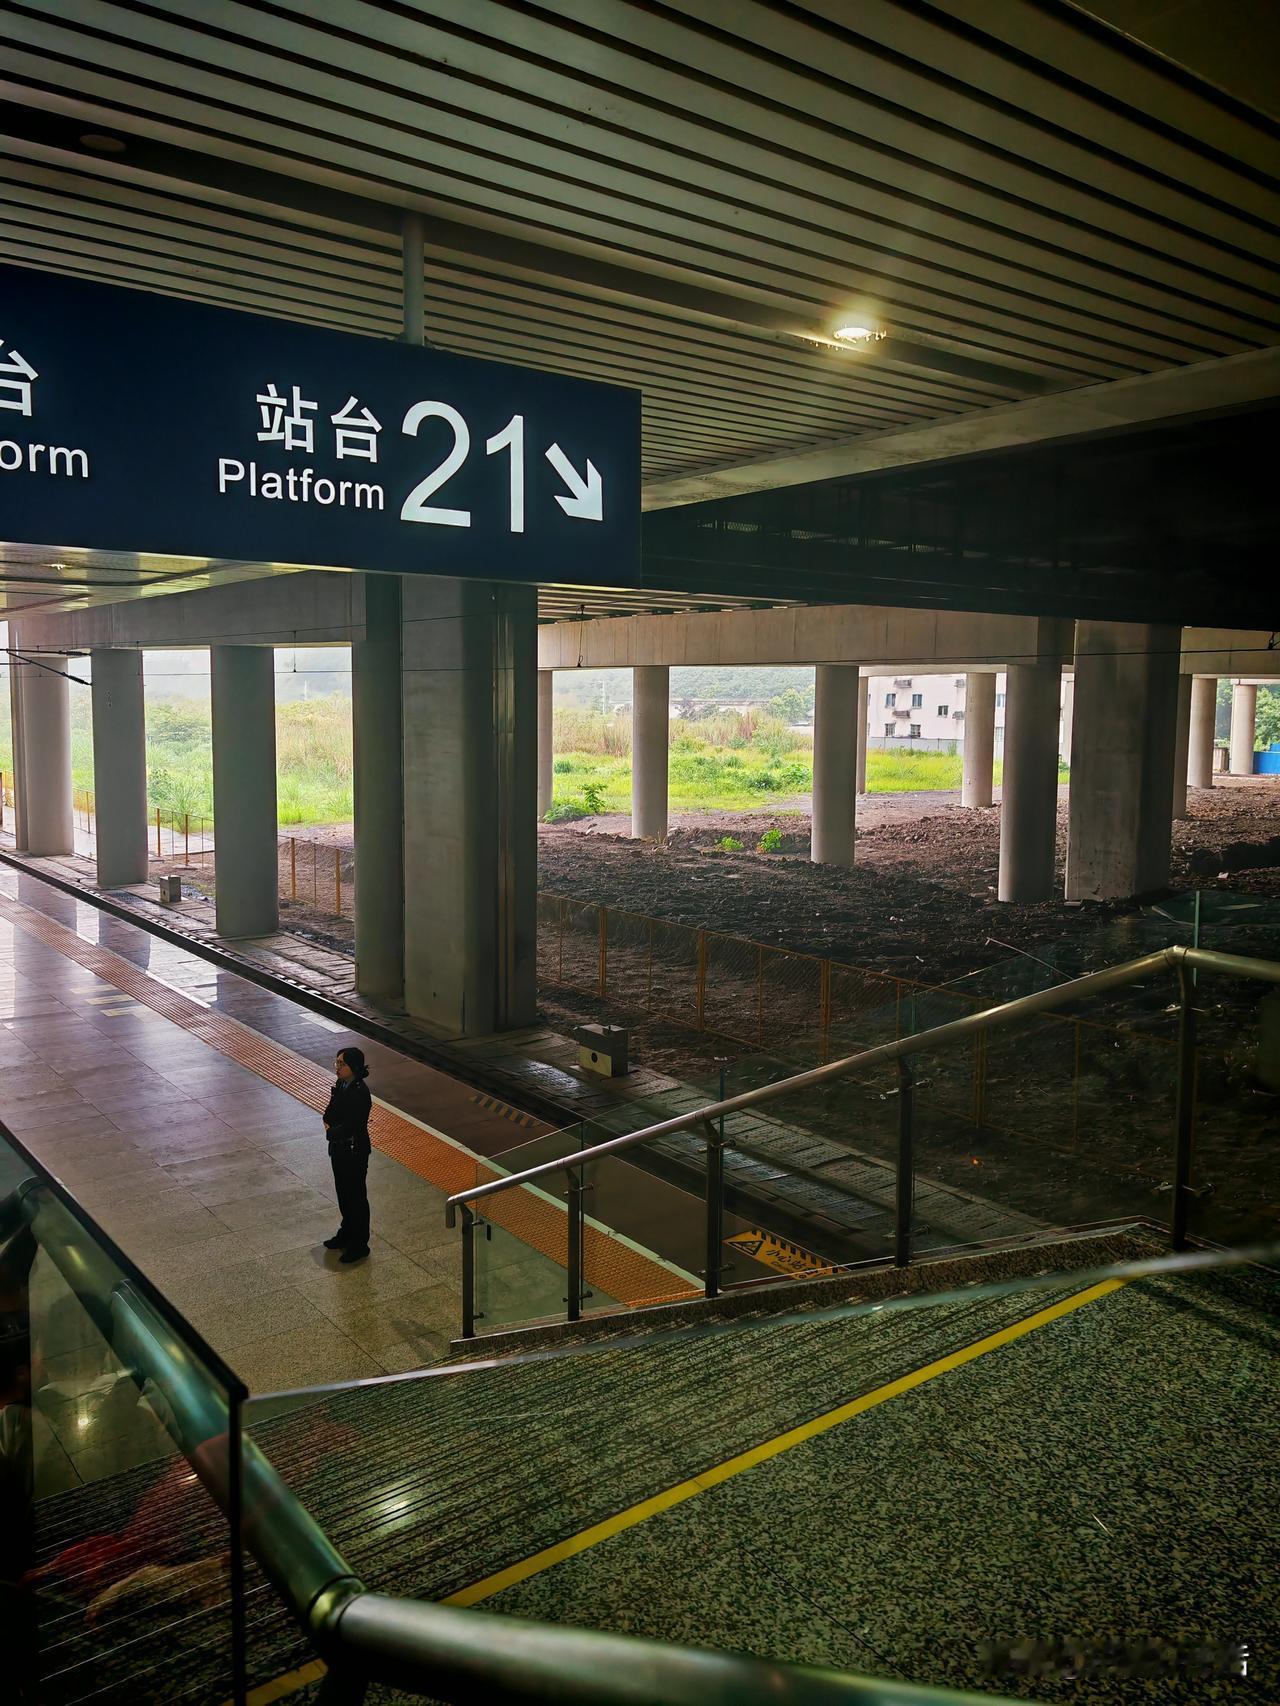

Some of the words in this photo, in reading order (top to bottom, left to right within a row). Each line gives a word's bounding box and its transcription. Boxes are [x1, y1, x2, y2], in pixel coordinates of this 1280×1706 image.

[255, 383, 384, 464] 站台
[0, 440, 89, 478] orm
[218, 457, 385, 510] Platform
[400, 399, 525, 534] 21
